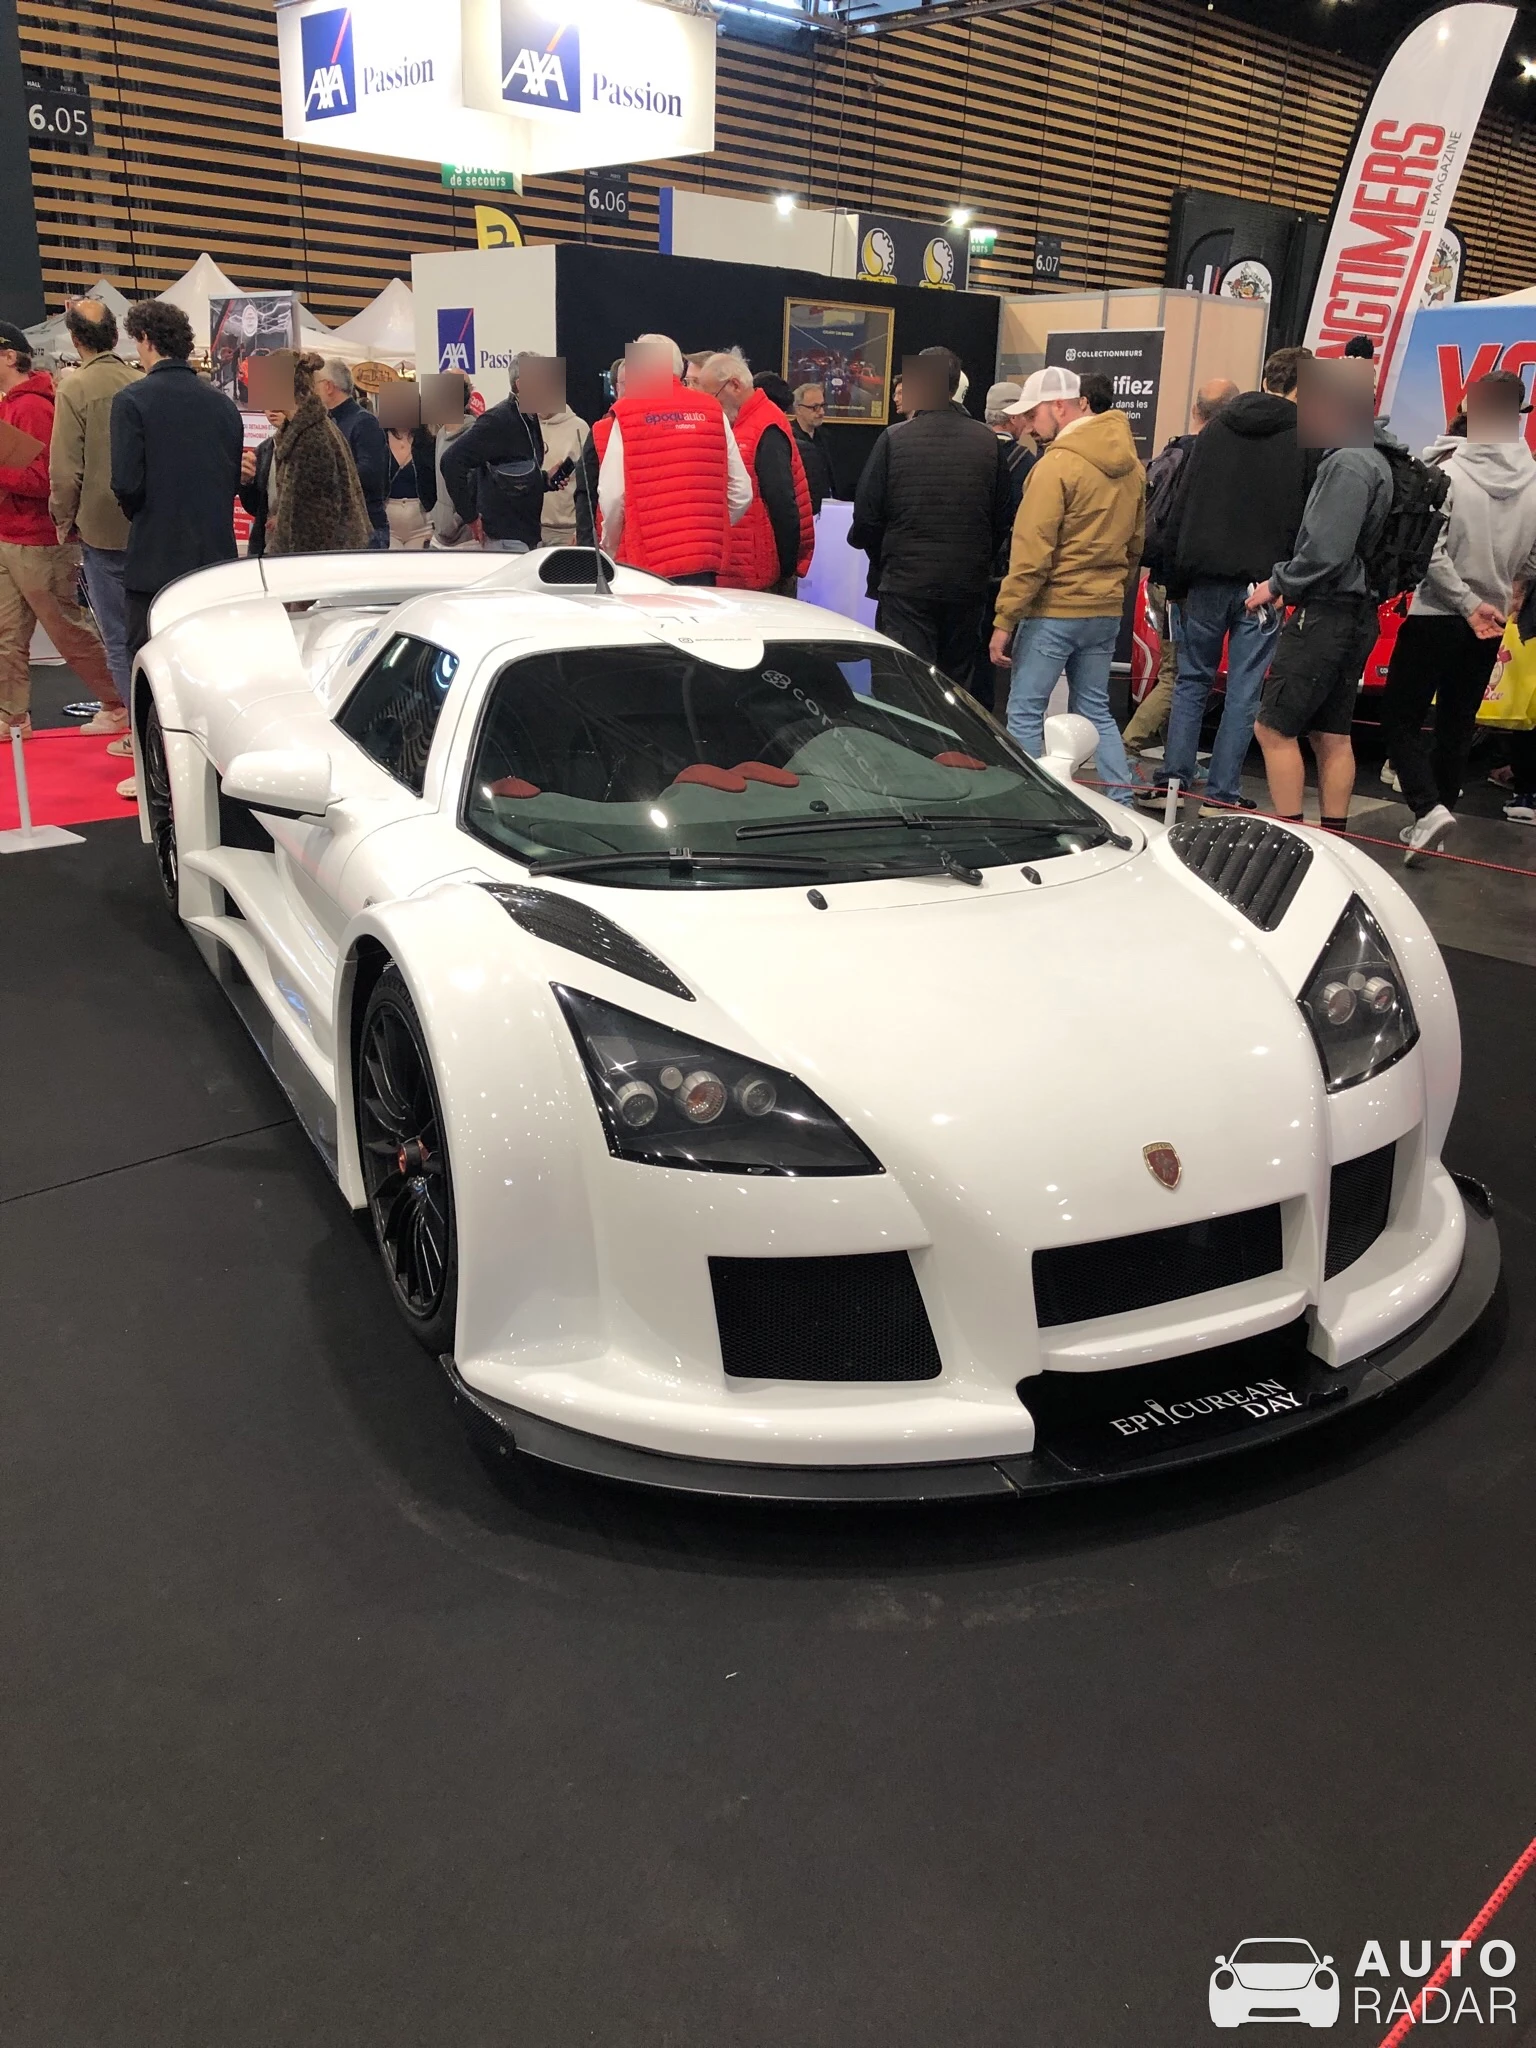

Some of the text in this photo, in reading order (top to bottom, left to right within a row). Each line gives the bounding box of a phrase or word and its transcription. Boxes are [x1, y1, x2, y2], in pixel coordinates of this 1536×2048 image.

[304, 57, 434, 112] AXA Passion
[502, 48, 682, 118] AXA Passion
[29, 104, 88, 136] 6.05
[450, 174, 506, 186] de secours
[1425, 131, 1462, 225] LE MAGAZINE
[589, 188, 626, 212] 6.06
[1315, 119, 1446, 366] NGTIMERS
[1036, 255, 1059, 272] 6.07
[439, 342, 514, 369] AXA Passi
[1077, 350, 1142, 358] COLLECTIONNEURS
[1113, 376, 1153, 395] ifiez
[1116, 400, 1148, 409] dans les
[1126, 411, 1141, 419] tion
[1110, 1379, 1287, 1436] EPICUREAN
[1240, 1392, 1302, 1418] DAY
